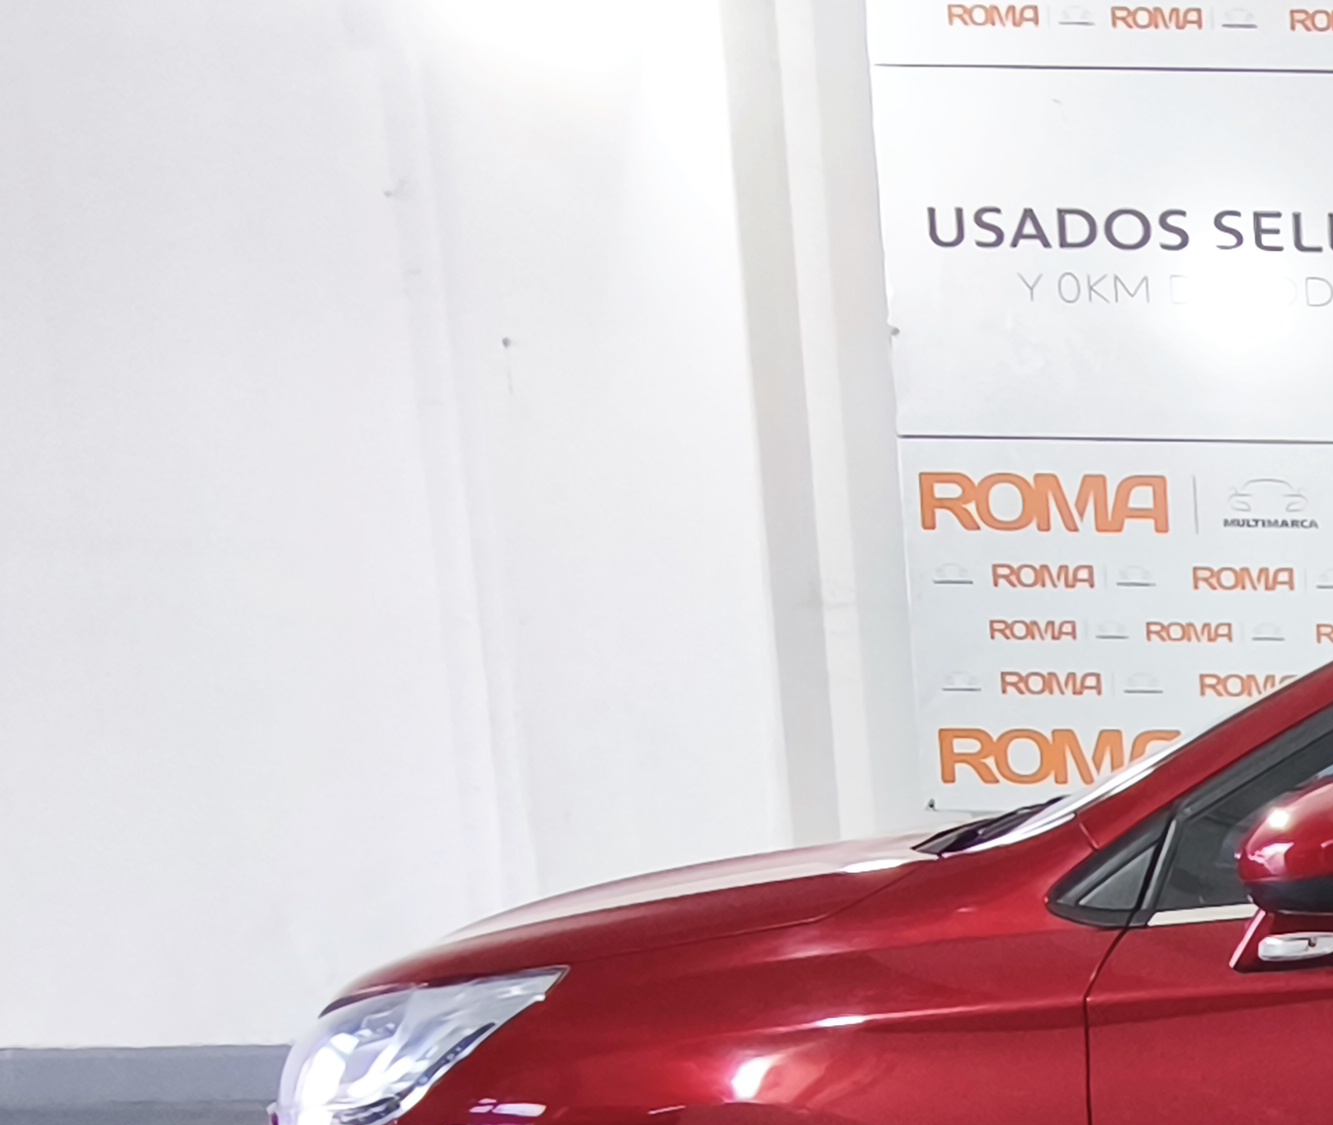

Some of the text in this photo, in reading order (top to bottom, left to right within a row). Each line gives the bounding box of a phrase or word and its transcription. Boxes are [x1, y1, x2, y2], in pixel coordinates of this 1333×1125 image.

[948, 4, 1040, 27] ROMA
[1110, 7, 1203, 30] ROMA
[927, 206, 1190, 251] USADOS
[1017, 273, 1043, 302] Y
[918, 472, 1170, 534] ROMA
[1223, 518, 1320, 530] MULTIMARCA
[992, 564, 1095, 589] ROMA
[1192, 566, 1295, 592] ROMA
[989, 620, 1077, 641] ROMA
[1145, 621, 1234, 643] ROMA
[1000, 671, 1298, 697] ROMA ROM
